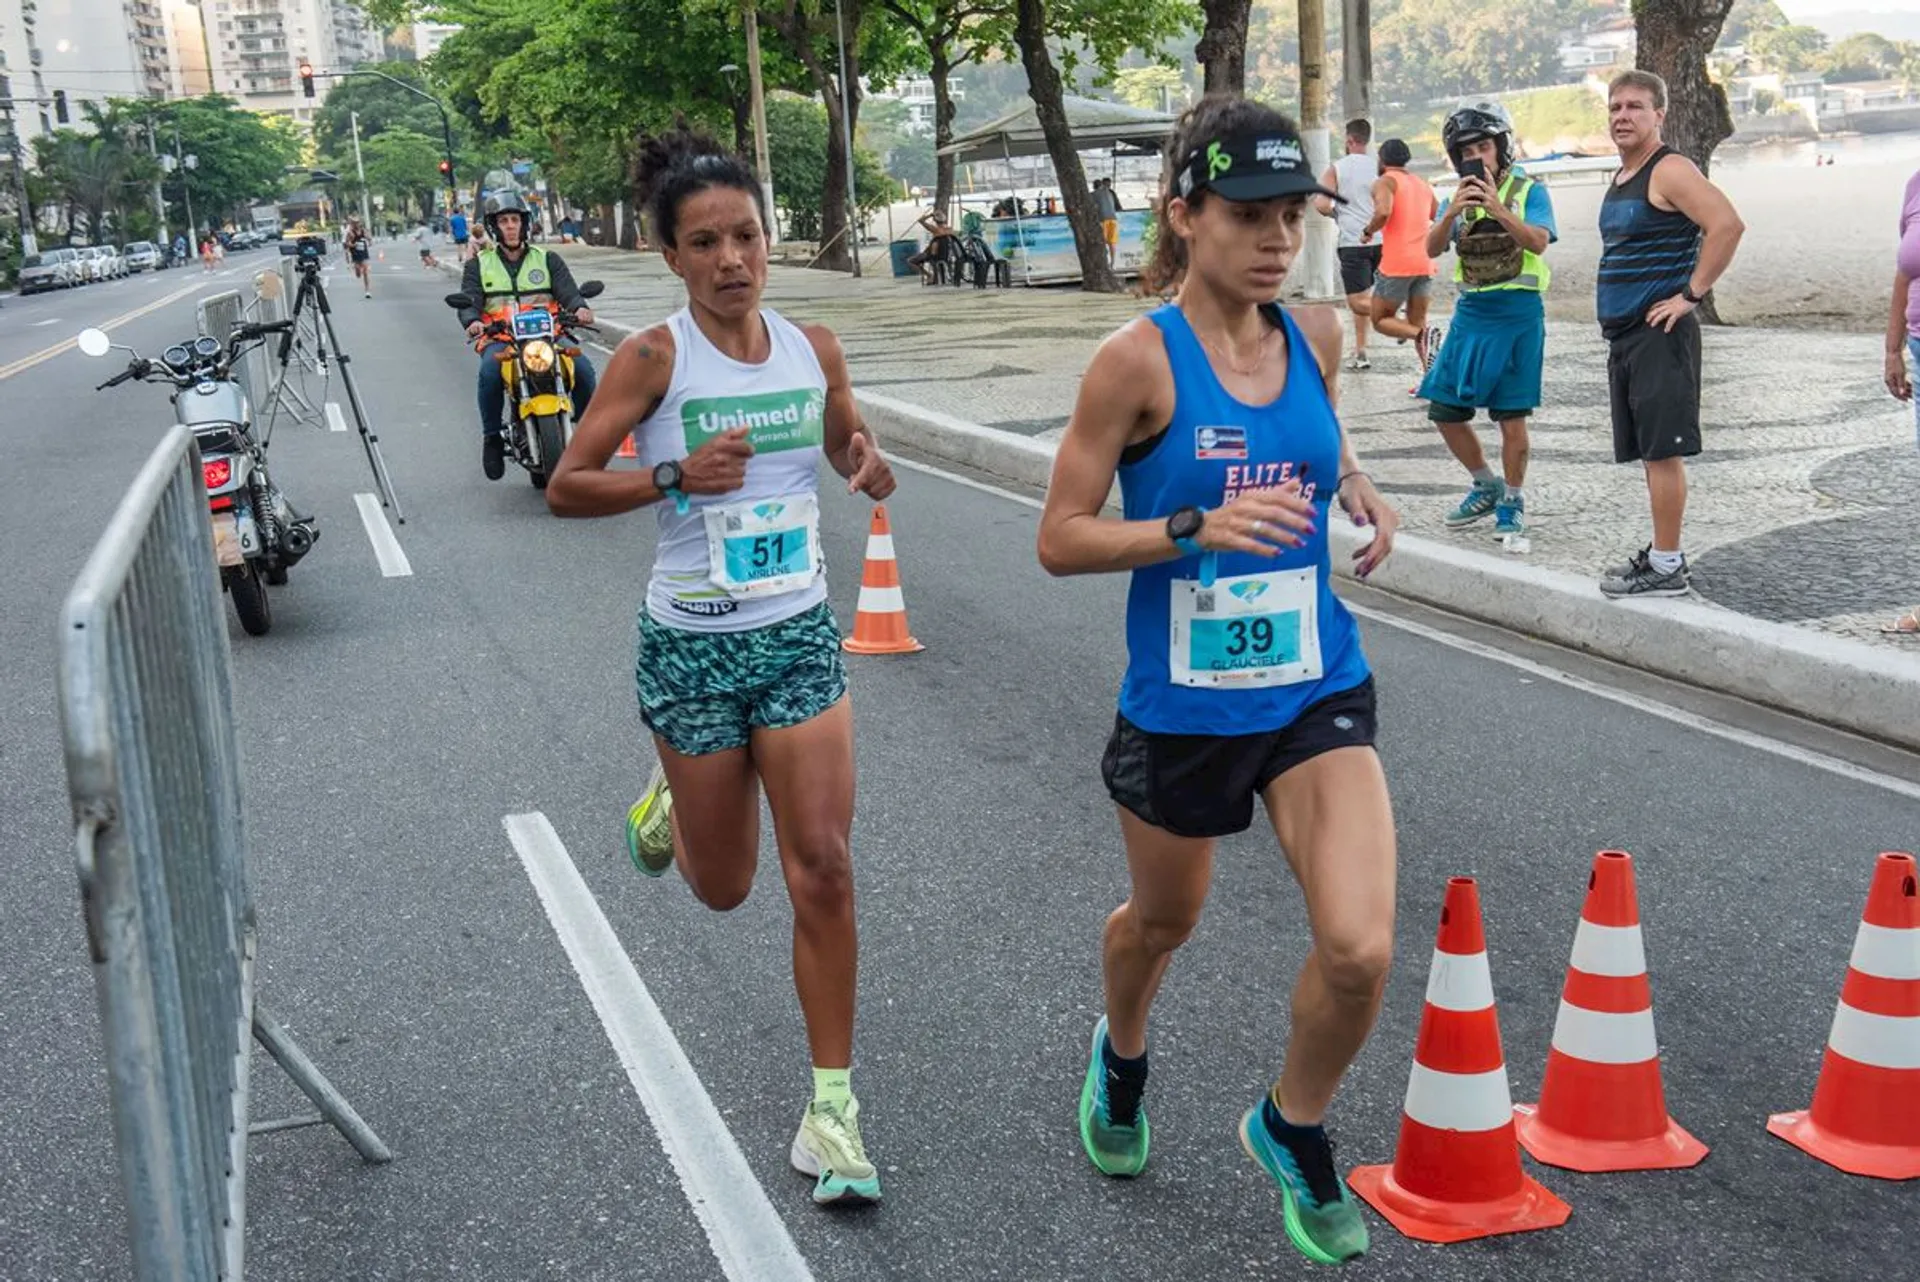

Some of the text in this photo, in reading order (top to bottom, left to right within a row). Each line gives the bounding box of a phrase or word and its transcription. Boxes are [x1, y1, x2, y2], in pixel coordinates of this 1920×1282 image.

[699, 402, 798, 432] Unimed
[751, 432, 789, 444] Serrana
[1226, 461, 1293, 488] ELITE
[241, 533, 251, 549] 6
[752, 533, 784, 567] 51
[1225, 617, 1274, 656] 39
[1211, 653, 1285, 671] GLAUCIELE
